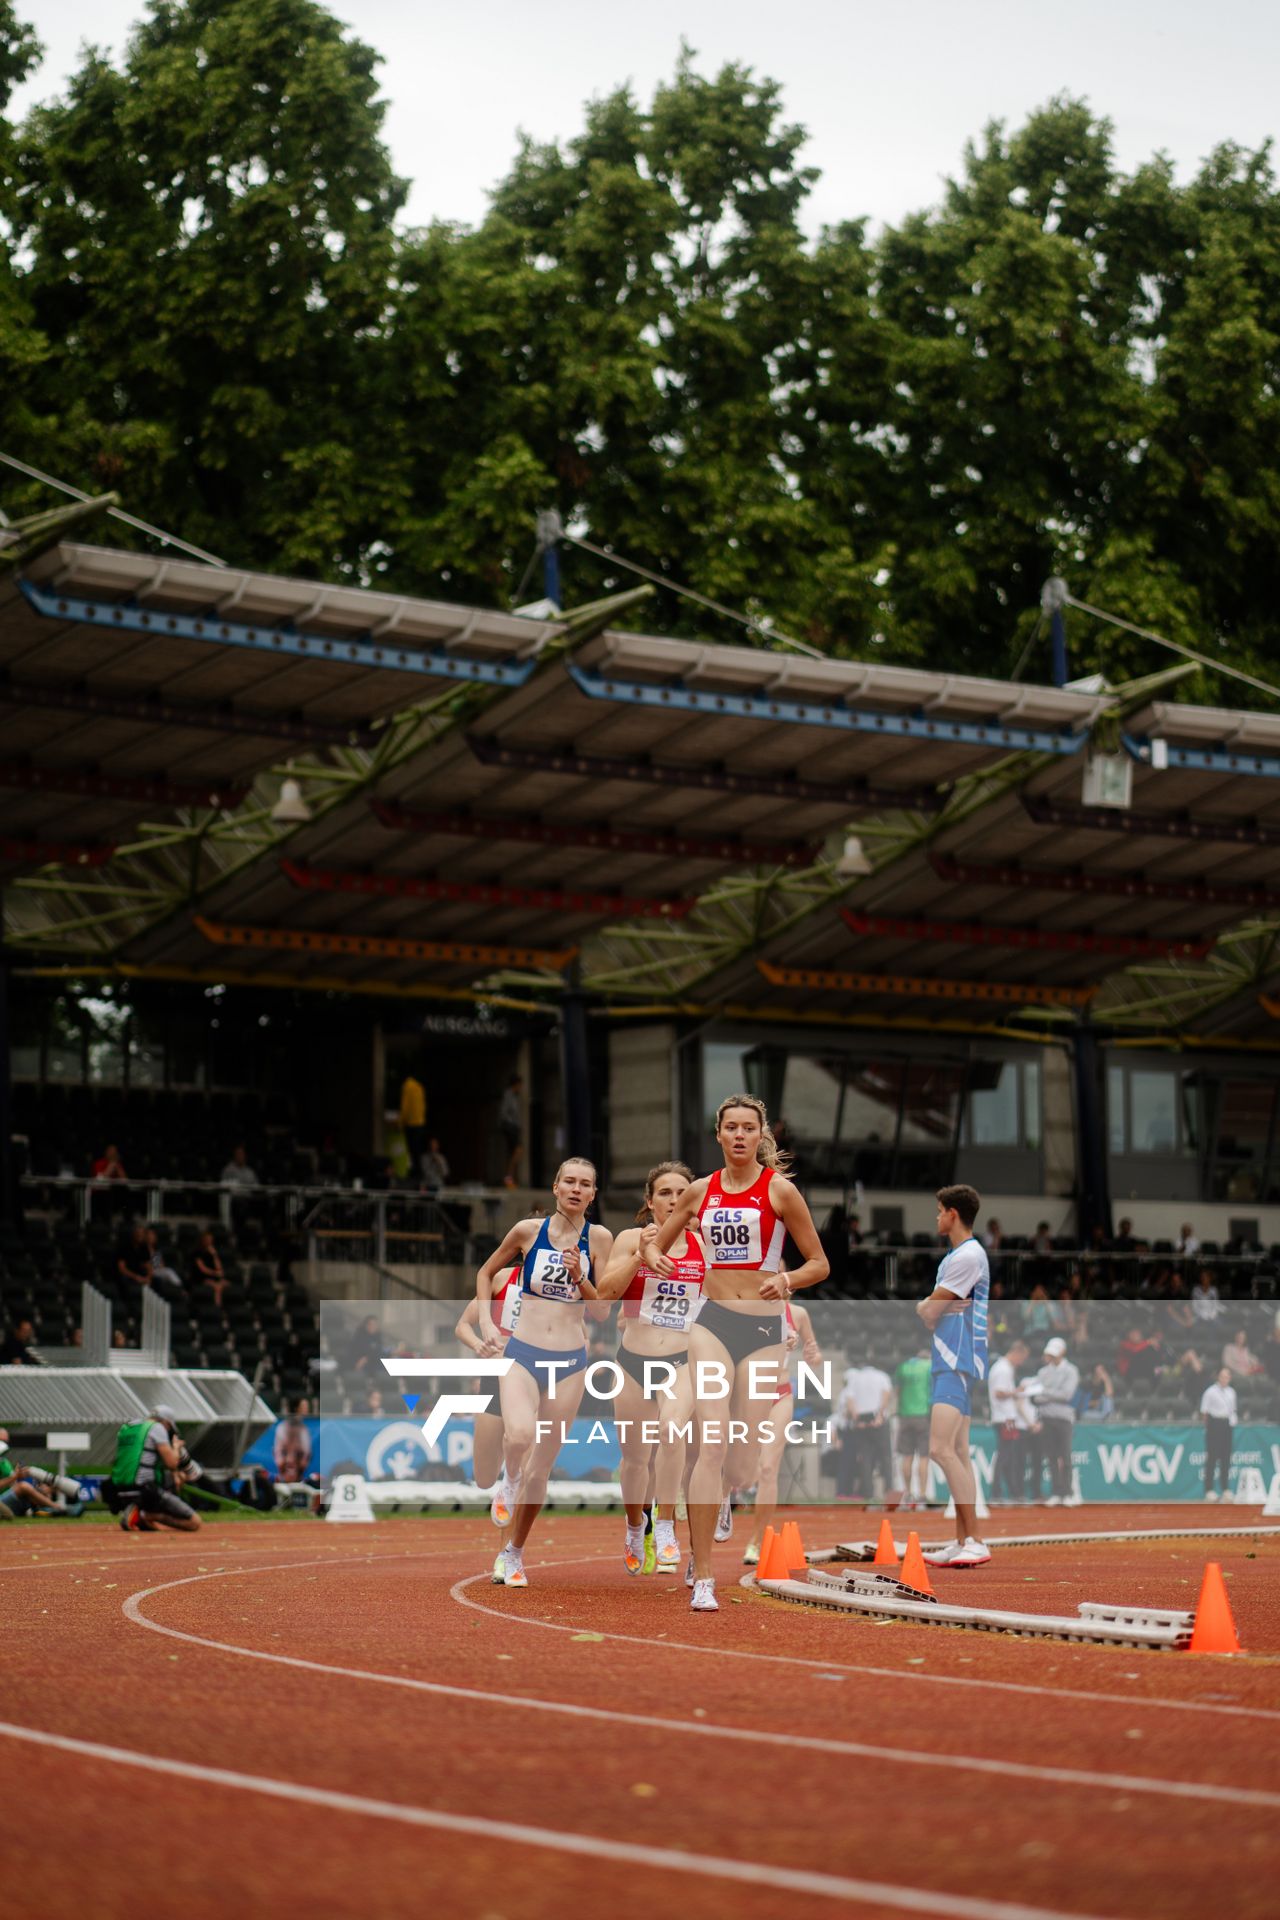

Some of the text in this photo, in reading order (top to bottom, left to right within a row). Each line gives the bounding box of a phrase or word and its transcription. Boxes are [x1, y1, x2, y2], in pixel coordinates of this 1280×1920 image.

[710, 1224, 750, 1246] 508
[727, 1249, 747, 1257] PLAN
[651, 1295, 690, 1316] 429
[1097, 1444, 1185, 1484] WGV
[343, 1484, 357, 1502] 8
